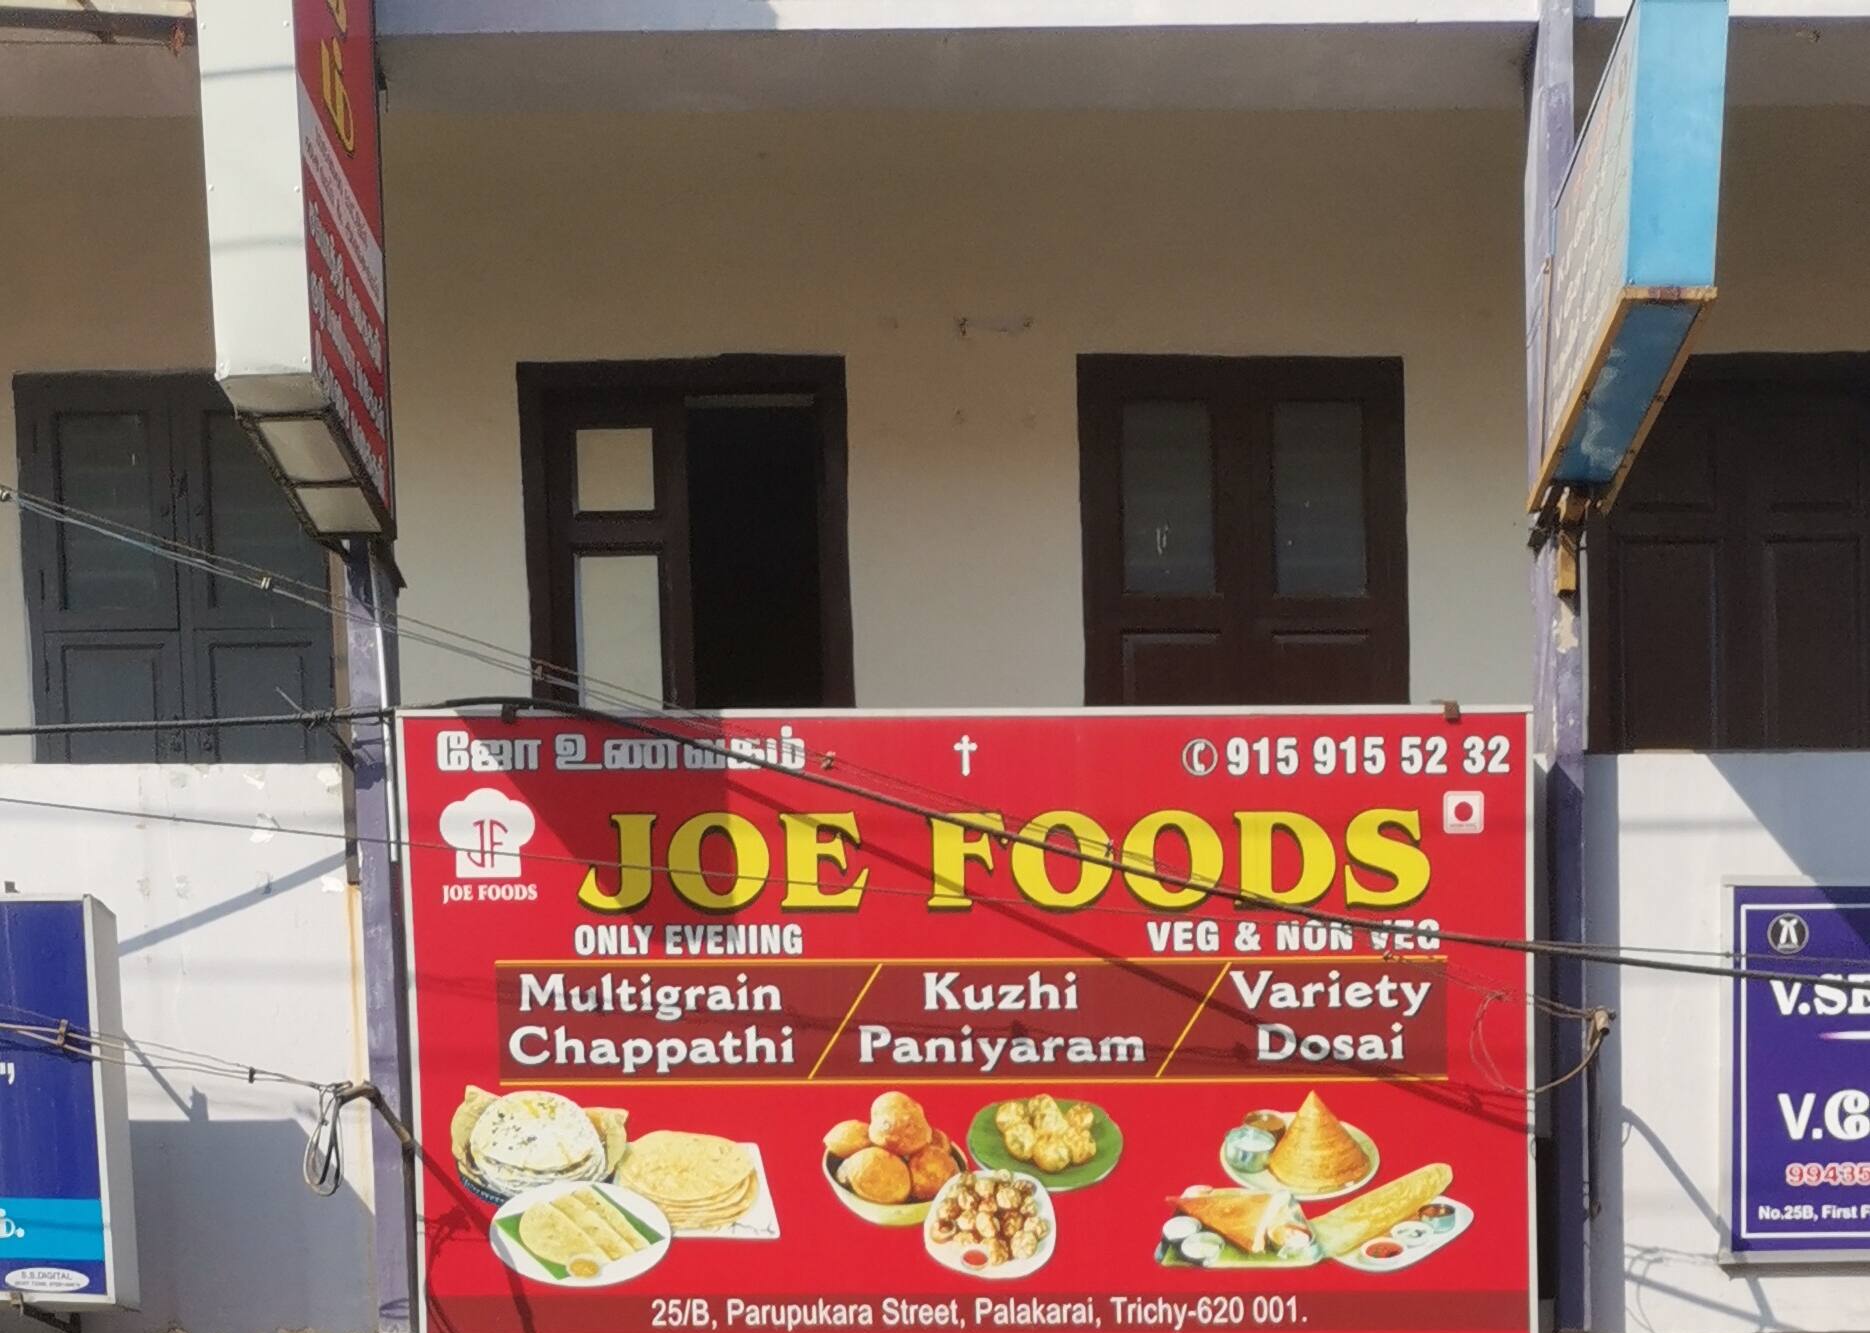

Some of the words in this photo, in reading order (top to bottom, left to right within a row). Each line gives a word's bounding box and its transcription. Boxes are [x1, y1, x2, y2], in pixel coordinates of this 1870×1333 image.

[436, 730, 542, 771] ஜோ
[554, 725, 805, 771] உணவகம்
[1227, 736, 1299, 776] 915
[1313, 736, 1386, 775] 915
[1401, 735, 1448, 775] 52
[1463, 735, 1511, 775] 32
[577, 811, 870, 914] JOE
[927, 808, 1432, 914] FOODS
[442, 885, 473, 904] JOE
[478, 883, 538, 901] FOODS
[574, 924, 653, 956] ONLY
[665, 923, 803, 956] EVENING
[1147, 921, 1220, 953] VEG
[1234, 920, 1262, 951] &
[1276, 919, 1353, 951] NON
[1370, 918, 1441, 950] VEG
[518, 972, 783, 1021] Multigrain
[922, 971, 1079, 1013] Kuzhi
[1230, 970, 1432, 1017] Variety
[508, 1025, 795, 1074] Chappathi
[858, 1024, 1146, 1072] Paniyaram
[1256, 1022, 1405, 1063] Dosai
[1785, 1162, 1870, 1187] 99435
[1821, 1205, 1858, 1219] First
[651, 1298, 717, 1330] 25/B,
[726, 1298, 873, 1332] Parupukara
[882, 1297, 966, 1330] Street,
[974, 1296, 1101, 1329] Palakarai,
[1110, 1295, 1242, 1330] Trichy-620
[1252, 1294, 1308, 1325] 001.
